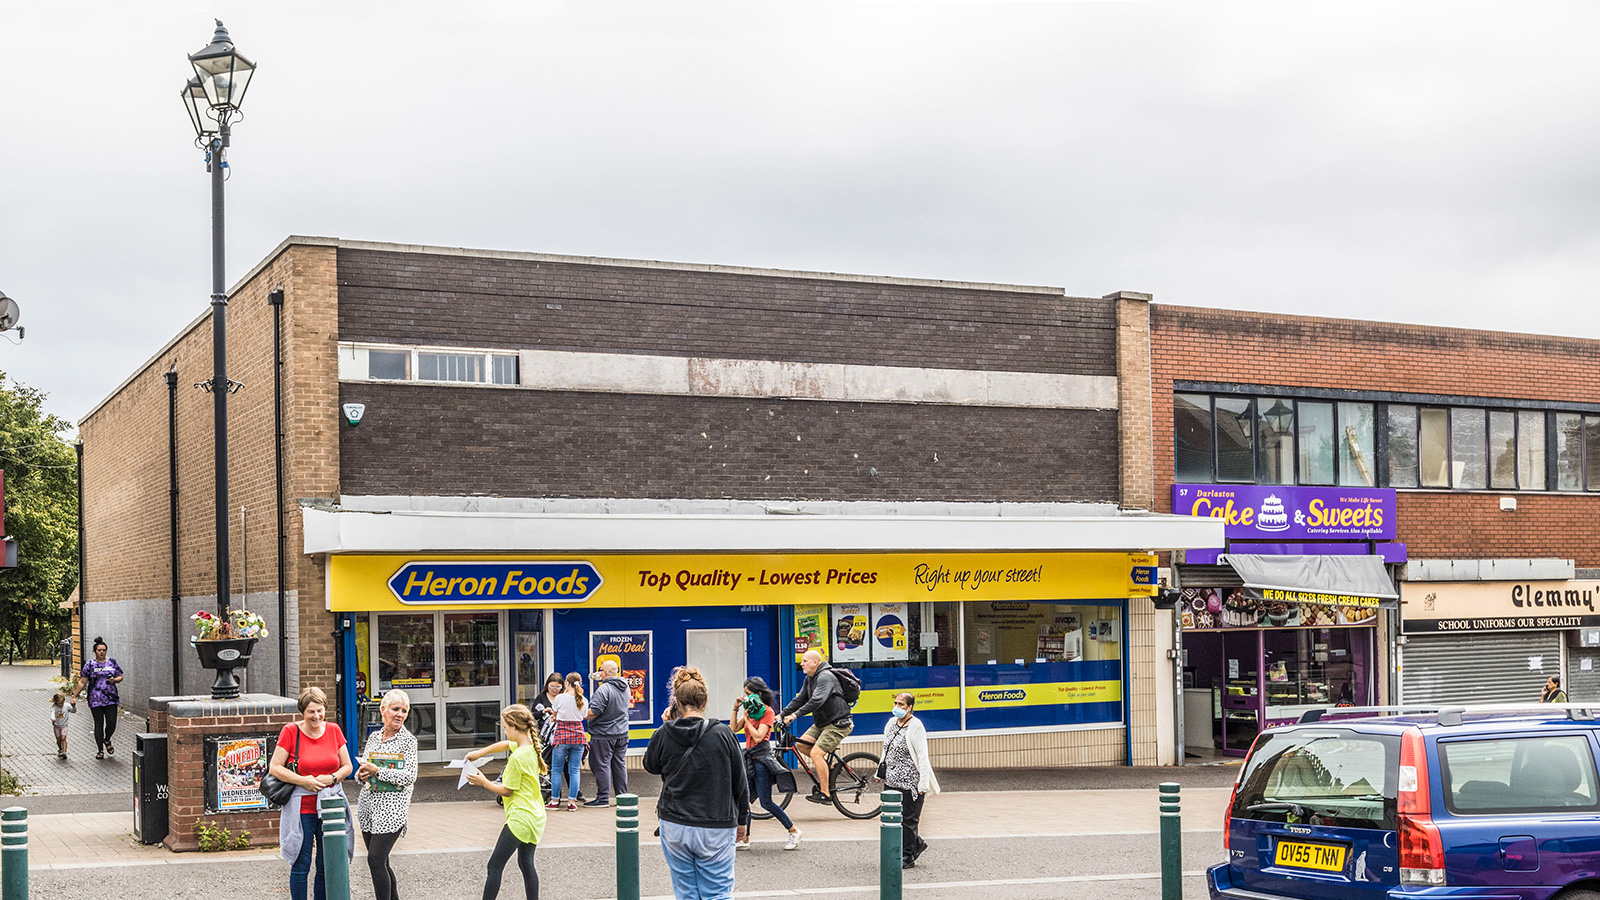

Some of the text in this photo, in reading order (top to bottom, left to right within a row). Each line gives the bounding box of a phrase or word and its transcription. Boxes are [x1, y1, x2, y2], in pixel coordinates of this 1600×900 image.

[1179, 488, 1188, 496] 57
[1196, 489, 1235, 498] Darlaston
[1191, 497, 1384, 527] Cake & Sweets
[1306, 527, 1328, 535] Catering
[402, 568, 589, 596] Heron Foods
[638, 570, 671, 592] Top
[675, 568, 742, 591] Quality
[759, 569, 821, 586] Lowest
[825, 568, 878, 585] Prices
[913, 563, 1043, 592] Right up your street!
[1263, 588, 1380, 608] WE DO ALL SIZES FRESH CREAM CAKES
[1438, 616, 1582, 630] SCHOOL UNIFORMS OUR SPECIALITY
[599, 641, 647, 654] Meal Deal
[896, 639, 904, 647] £1
[980, 690, 1025, 701] Heron Foods
[225, 747, 260, 767] FUNFAIR
[221, 788, 261, 797] WEDNESBUR
[1289, 826, 1312, 834] VOLVO
[1231, 849, 1245, 858] V70
[1281, 844, 1340, 867] OV55 TNN
